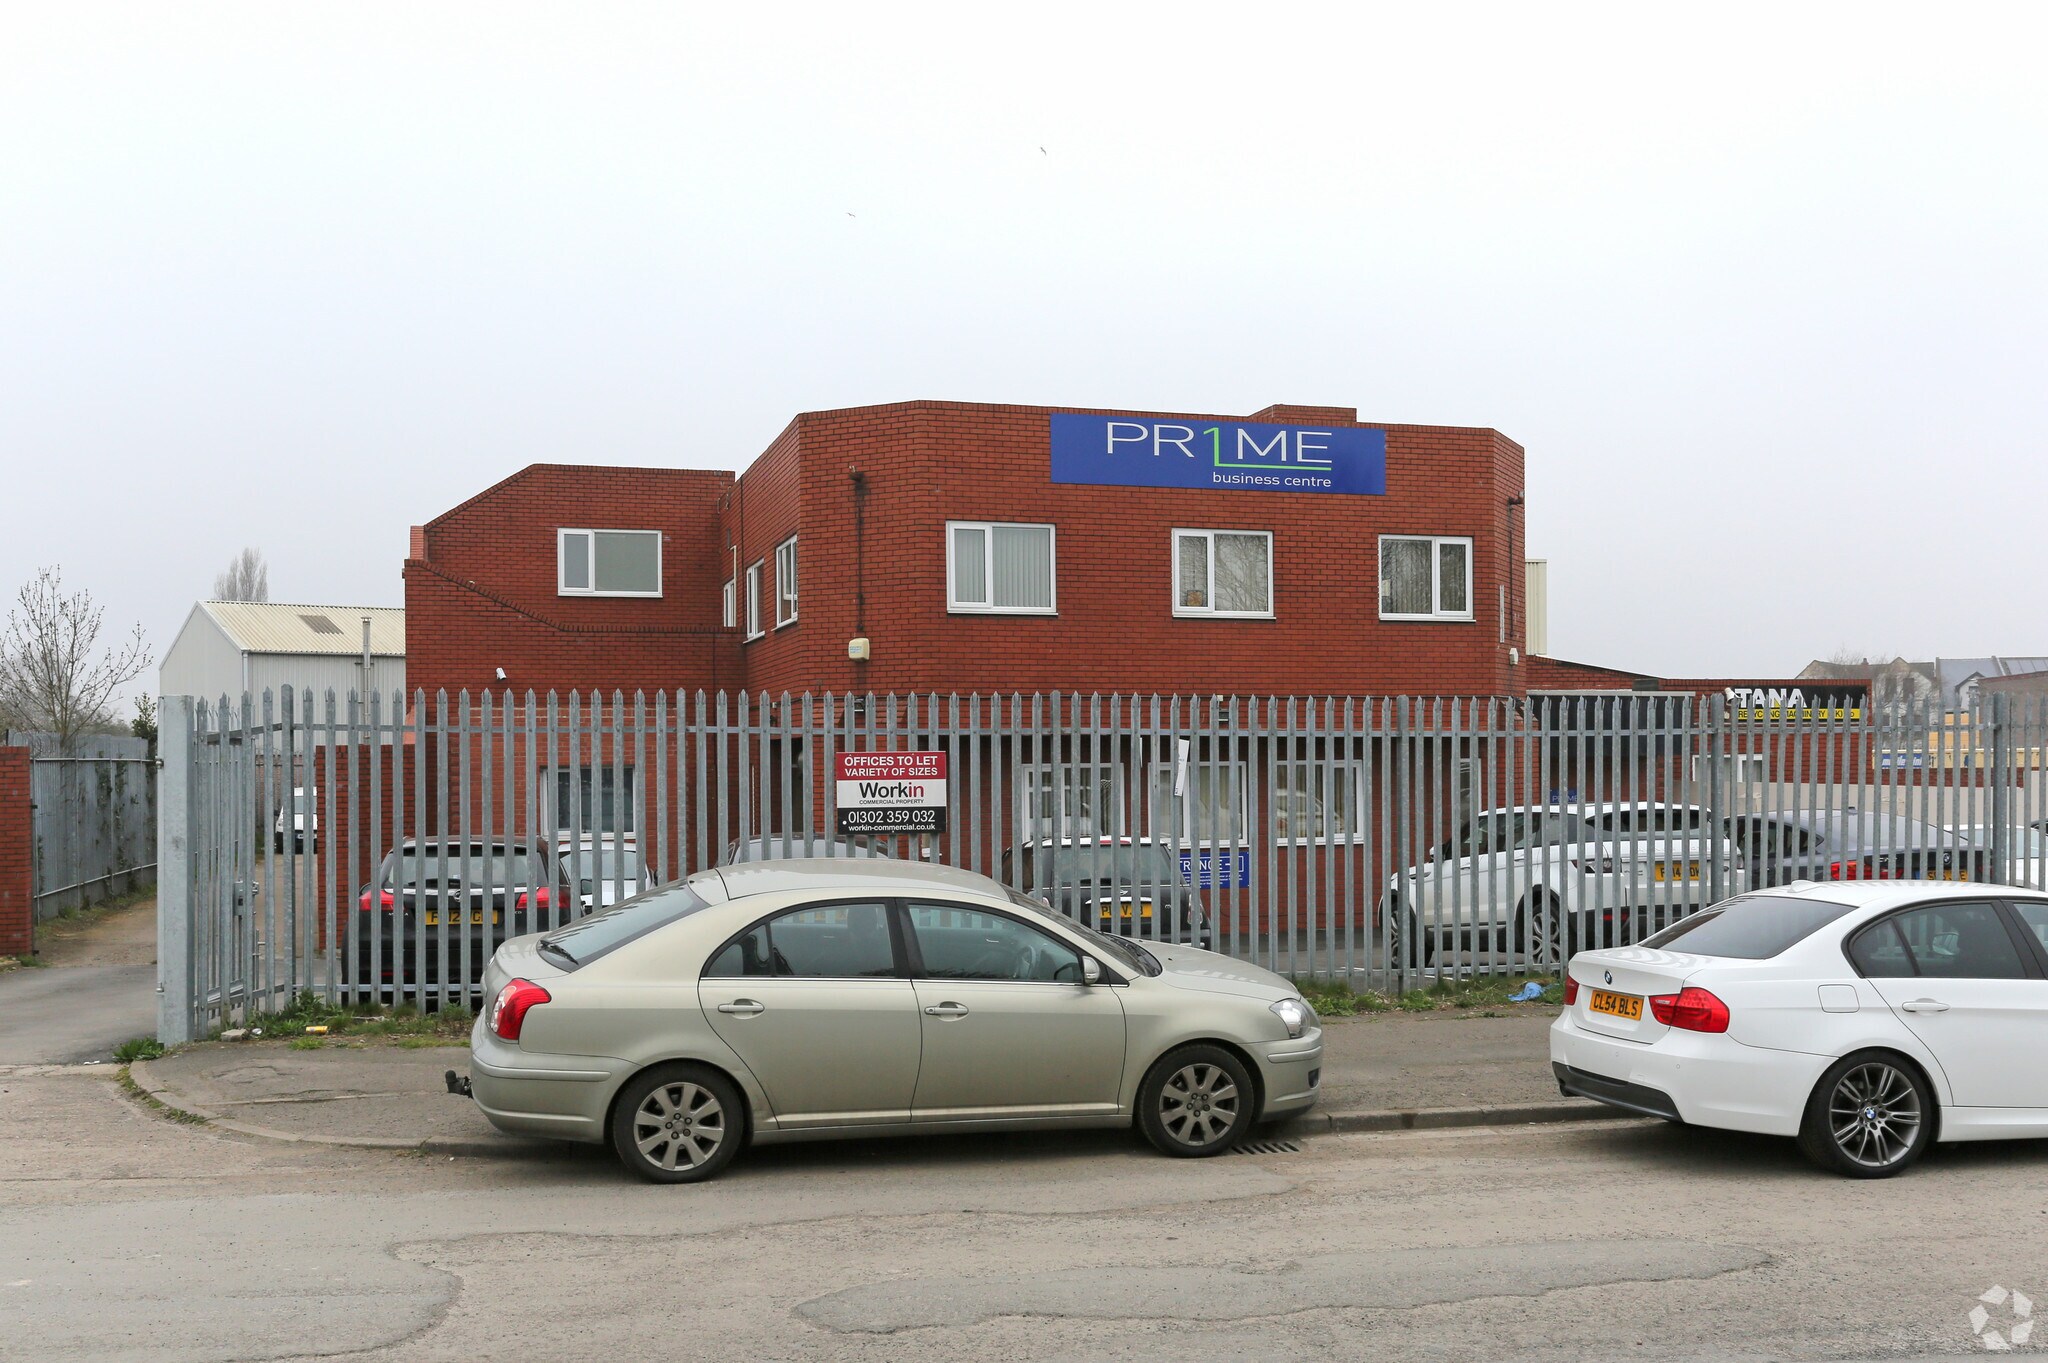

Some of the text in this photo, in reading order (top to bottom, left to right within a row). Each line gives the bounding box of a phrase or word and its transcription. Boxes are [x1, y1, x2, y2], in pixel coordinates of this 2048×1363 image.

[1212, 471, 1332, 488] business centre
[1734, 687, 1808, 709] TANA
[844, 755, 938, 767] OFFICES TO LET
[845, 767, 938, 777] VARIETY OF SIZES
[859, 781, 924, 799] Workin
[848, 810, 936, 824] 01302 359 032
[848, 823, 936, 832] workin-commercial.co.uk
[1593, 992, 1639, 1017] CL54 BLS
